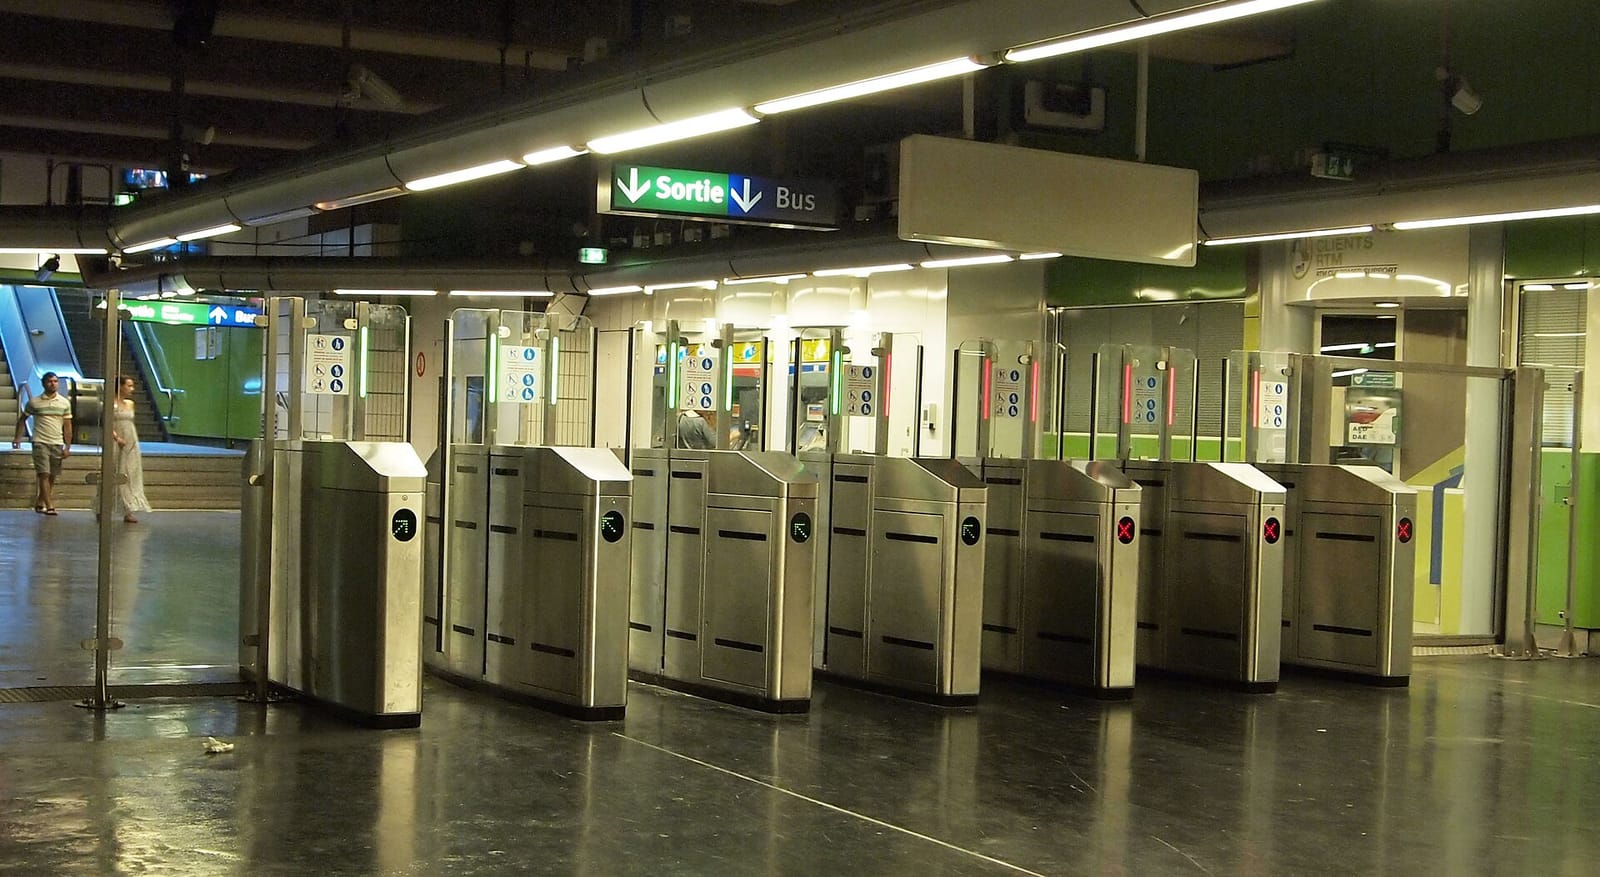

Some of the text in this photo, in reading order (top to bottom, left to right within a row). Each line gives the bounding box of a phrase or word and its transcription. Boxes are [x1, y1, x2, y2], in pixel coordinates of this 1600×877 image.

[655, 175, 724, 204] Sortie
[776, 186, 816, 211] Bus
[1316, 236, 1373, 252] CLIENTS
[1316, 252, 1343, 267] RTM
